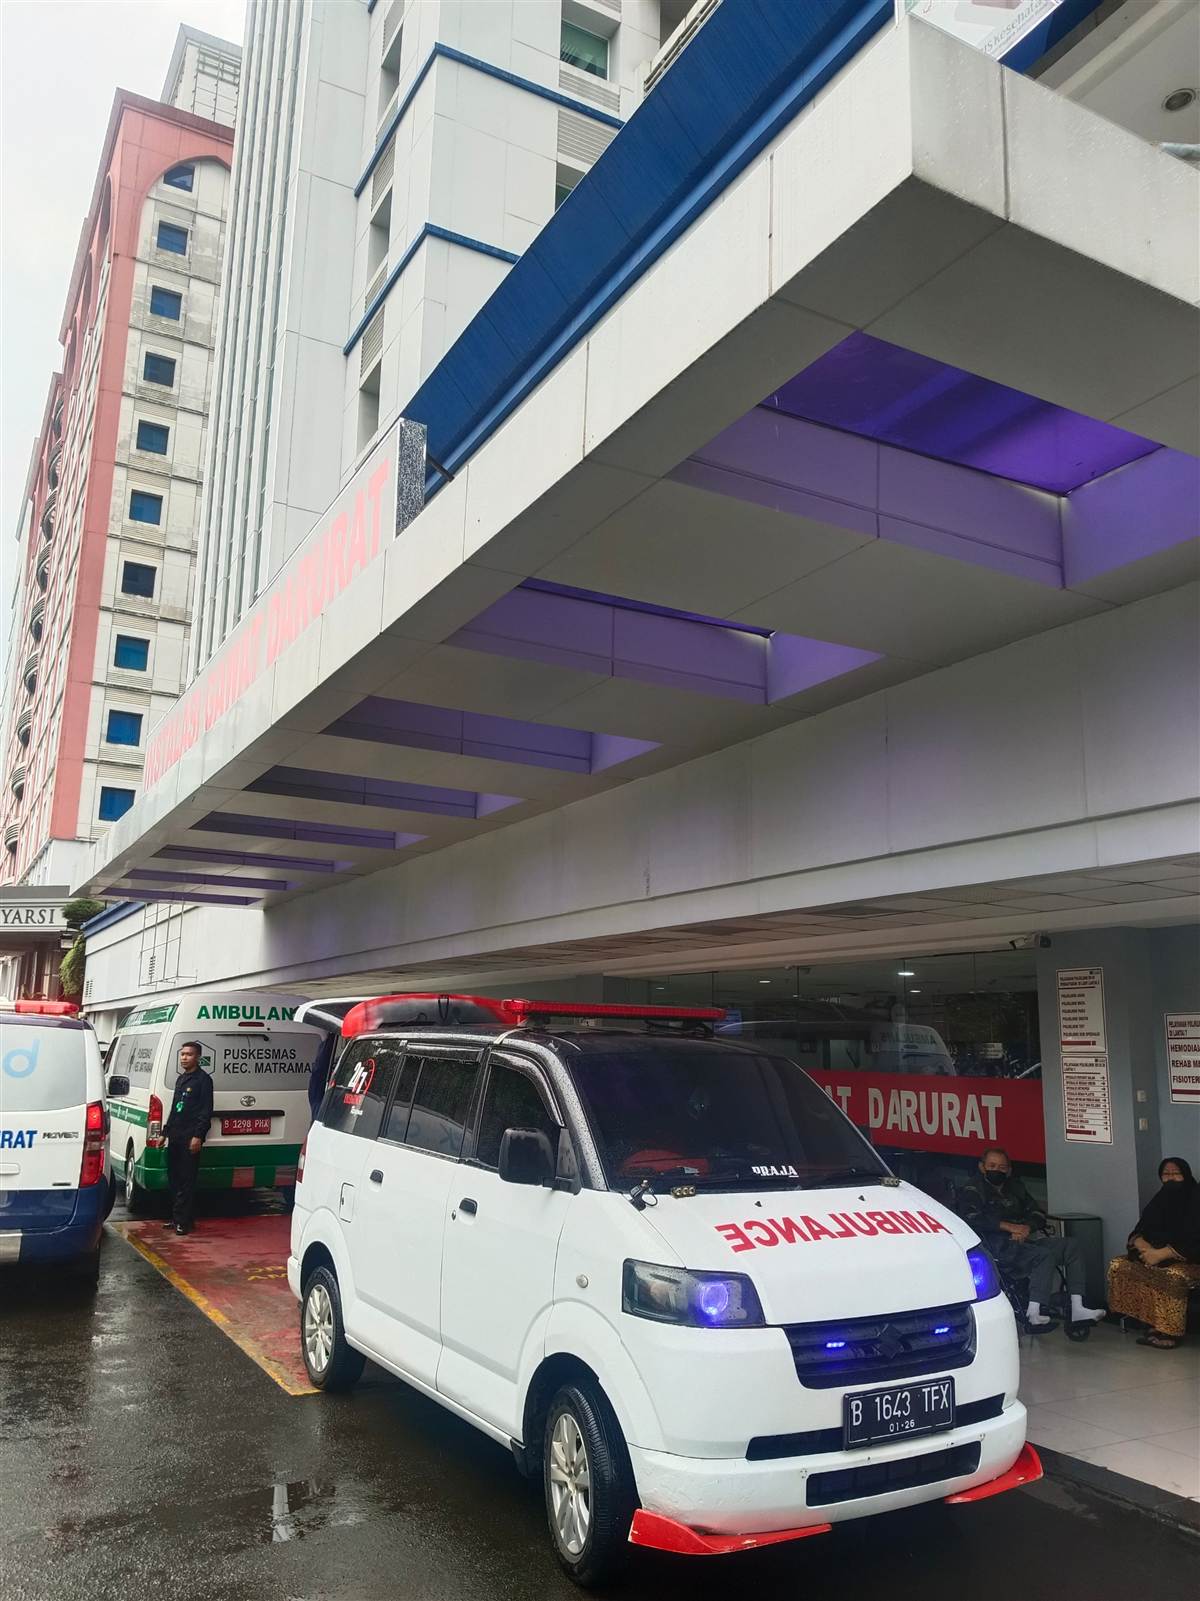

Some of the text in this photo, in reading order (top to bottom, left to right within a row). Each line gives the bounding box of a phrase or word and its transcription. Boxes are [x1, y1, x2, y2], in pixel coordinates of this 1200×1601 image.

[267, 457, 390, 668] DARURAT
[1, 908, 56, 924] YARSI
[197, 1005, 295, 1021] AMBULAN
[223, 1048, 296, 1060] PUSKESMAS
[223, 1062, 314, 1074] KEC. MATRAMA
[1172, 1060, 1191, 1068] REHAB
[868, 1087, 1003, 1141] DARURAT
[0, 1130, 38, 1149] RAT
[850, 1384, 949, 1426] B 1643 TFX
